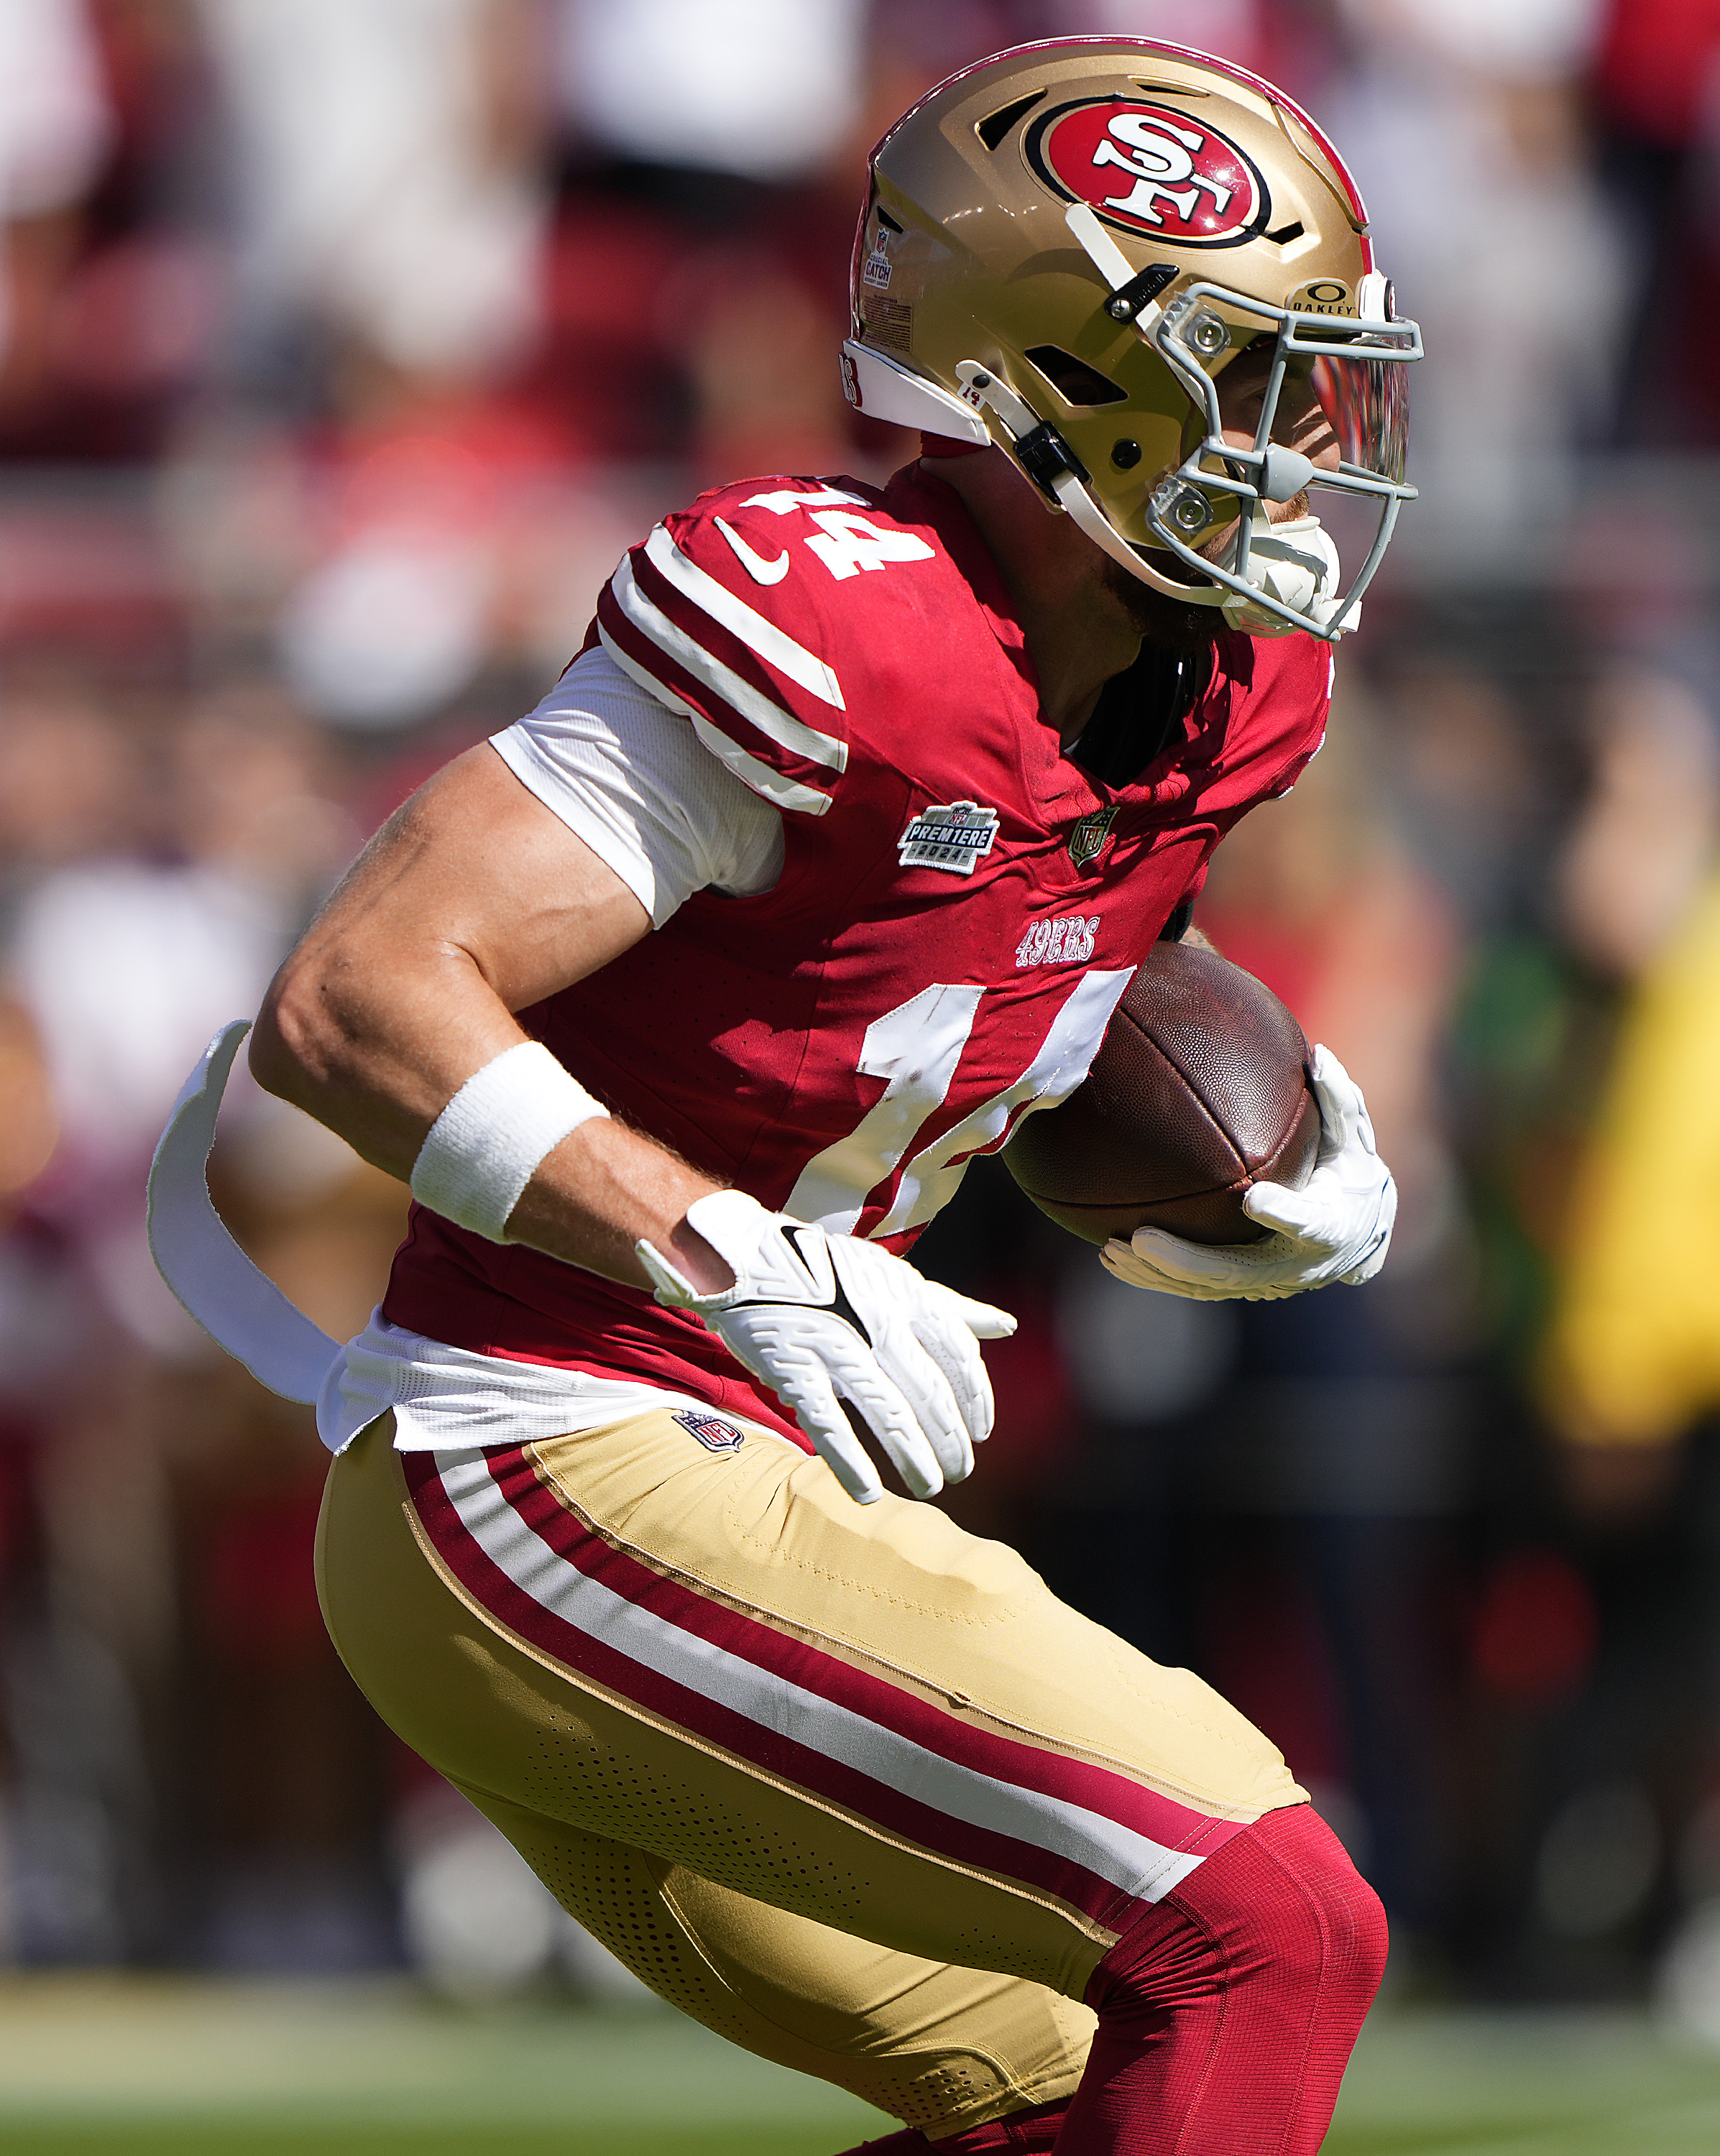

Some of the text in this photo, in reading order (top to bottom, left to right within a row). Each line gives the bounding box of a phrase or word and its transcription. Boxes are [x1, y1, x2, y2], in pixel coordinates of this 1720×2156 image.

[1091, 112, 1234, 227] SF
[865, 261, 891, 282] CATCH
[1293, 302, 1353, 315] OAKLEY
[961, 386, 981, 407] 14
[949, 813, 967, 826] NFL
[1015, 915, 1101, 968] 49ERS
[699, 1422, 736, 1443] NFL
